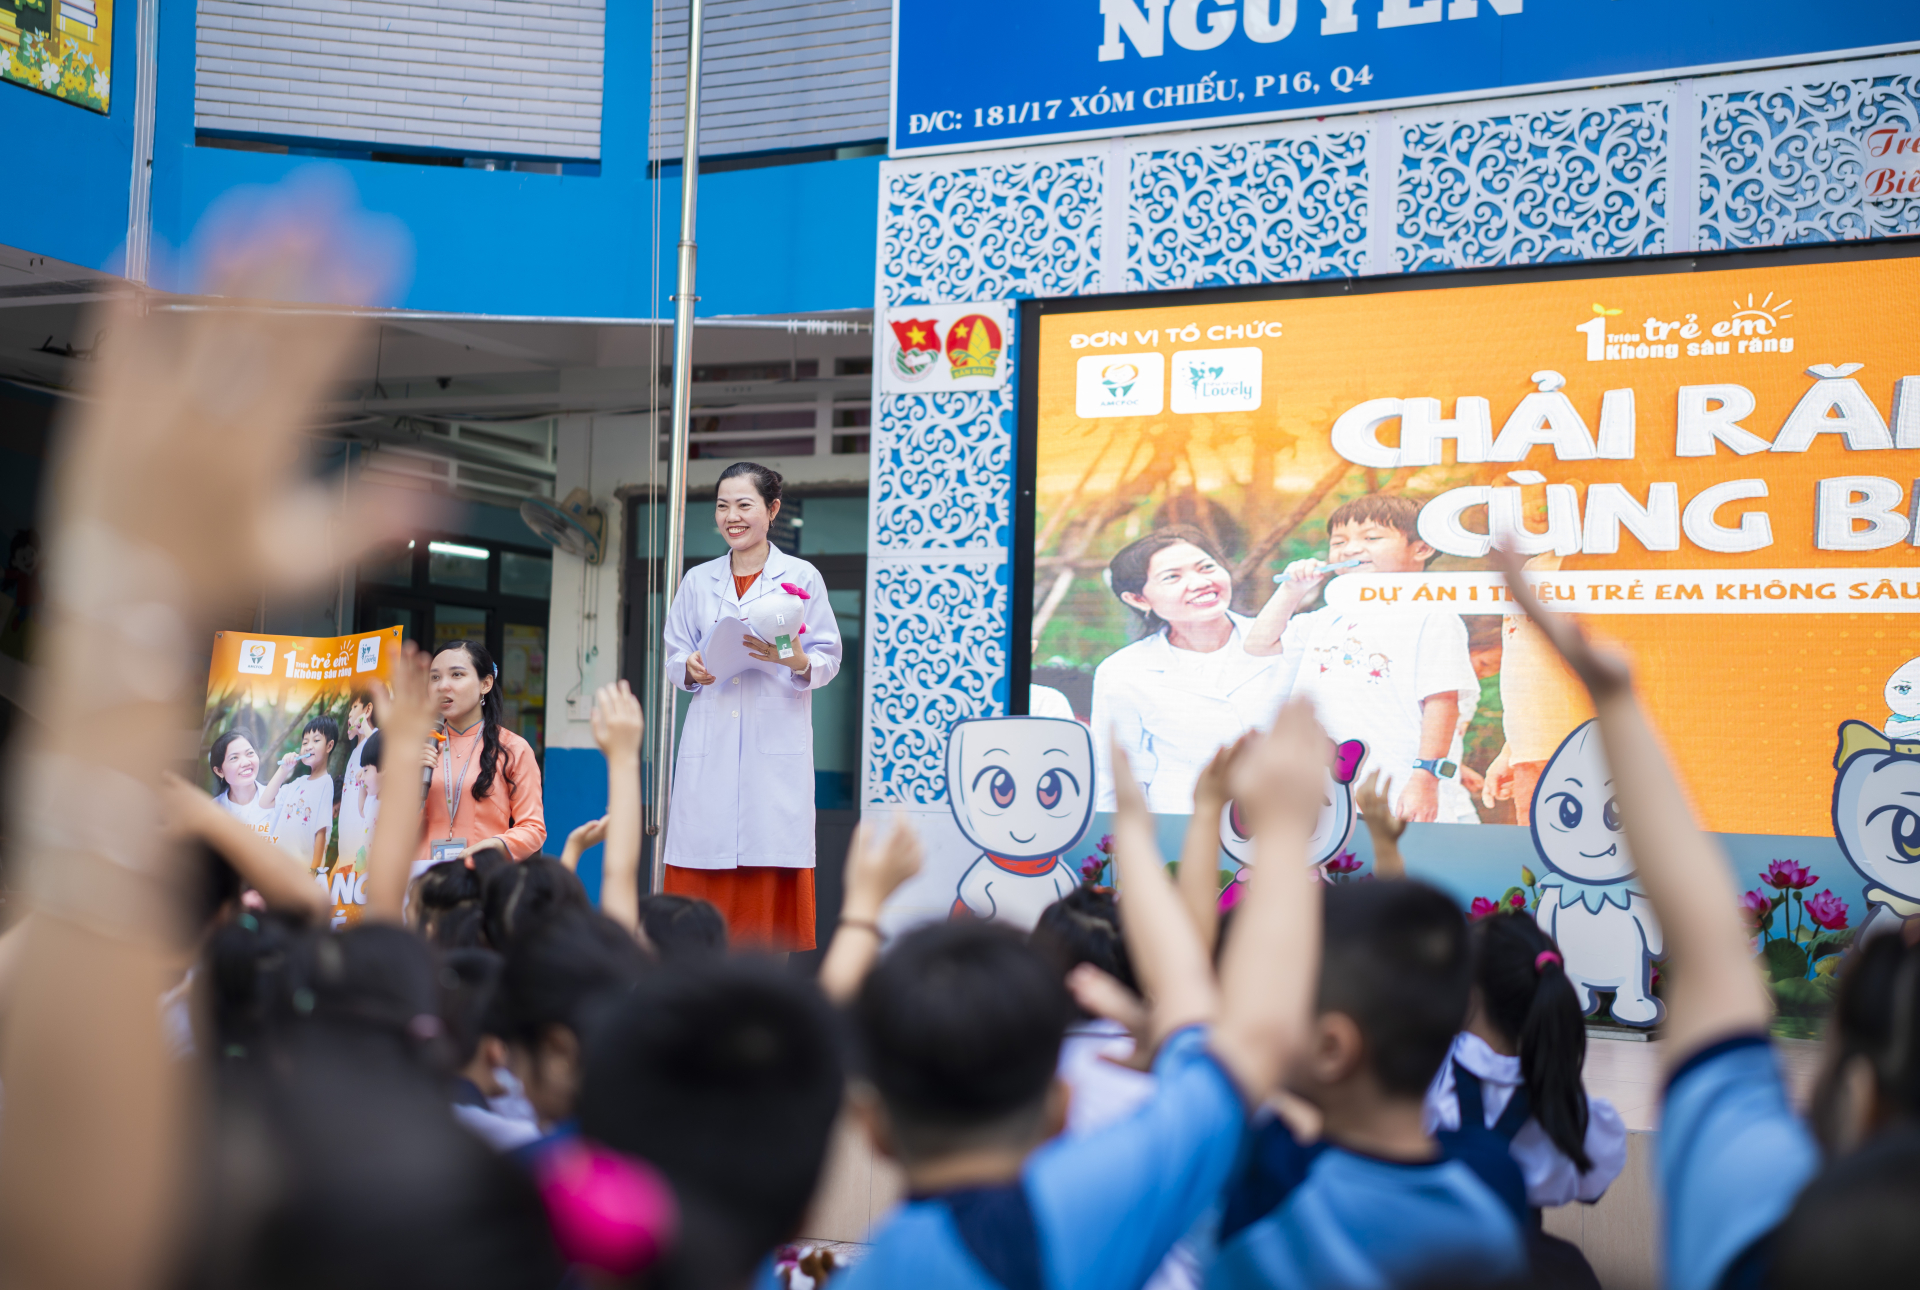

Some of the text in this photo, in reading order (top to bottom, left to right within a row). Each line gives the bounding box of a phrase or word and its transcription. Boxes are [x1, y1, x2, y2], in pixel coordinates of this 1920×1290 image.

[909, 64, 1374, 135] Đ/C: 181/17 XÓM CHIẾU, P16, Q4
[1069, 320, 1283, 349] ĐƠN VỊ TỔ CHỨC
[1576, 317, 1606, 361] 1
[1643, 313, 1702, 342] trẻ
[1711, 318, 1773, 338] em
[1606, 336, 1794, 360] Không sâu răng
[1202, 380, 1253, 400] Lovely
[1331, 363, 1920, 468] CHẢI RĂ
[1417, 470, 1774, 558] CÙNG
[1359, 586, 1402, 605] DỰ
[1411, 583, 1457, 601] ÁN
[1468, 586, 1478, 601] 1
[1587, 579, 1644, 601] TRẺ
[1655, 584, 1704, 600] EM
[1716, 579, 1837, 600] KHÔNG
[284, 650, 296, 677] 1
[294, 668, 322, 680] Không
[311, 653, 331, 669] trẻ
[333, 656, 349, 668] em
